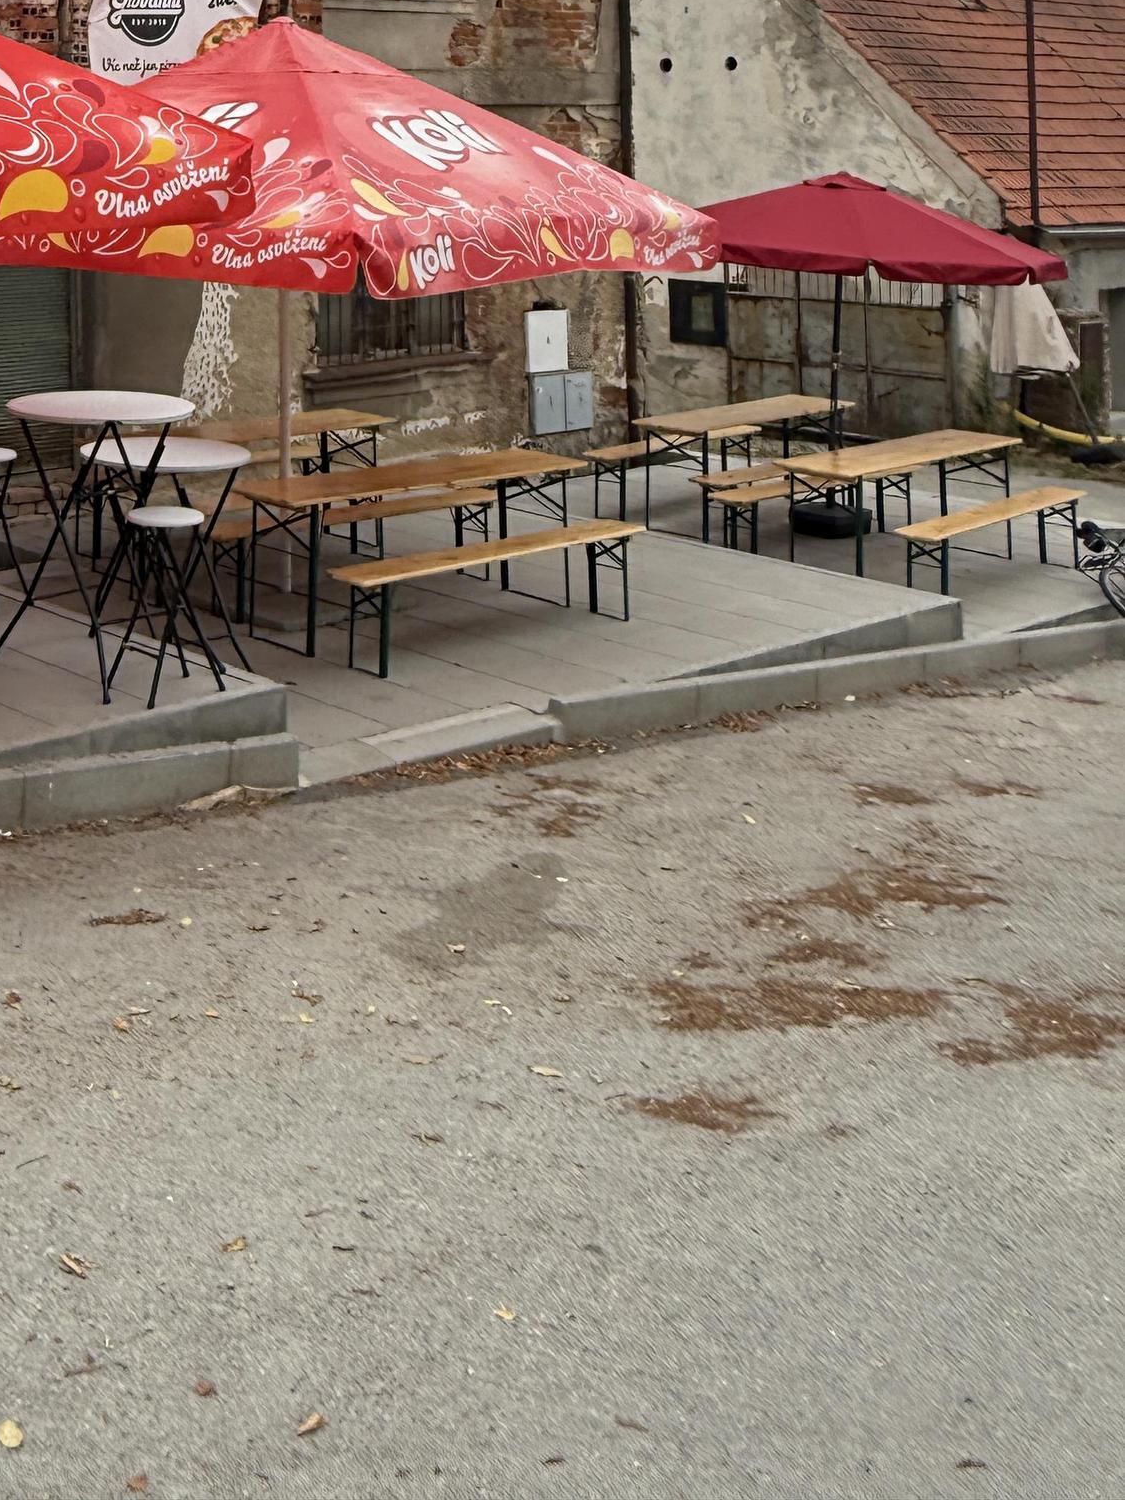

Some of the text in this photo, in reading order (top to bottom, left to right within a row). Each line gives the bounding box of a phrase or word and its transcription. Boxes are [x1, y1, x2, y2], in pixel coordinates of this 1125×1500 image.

[122, 56, 141, 72] než
[139, 59, 159, 78] jen
[95, 157, 231, 219] Vlna osvěžení
[211, 243, 255, 270] Vlna
